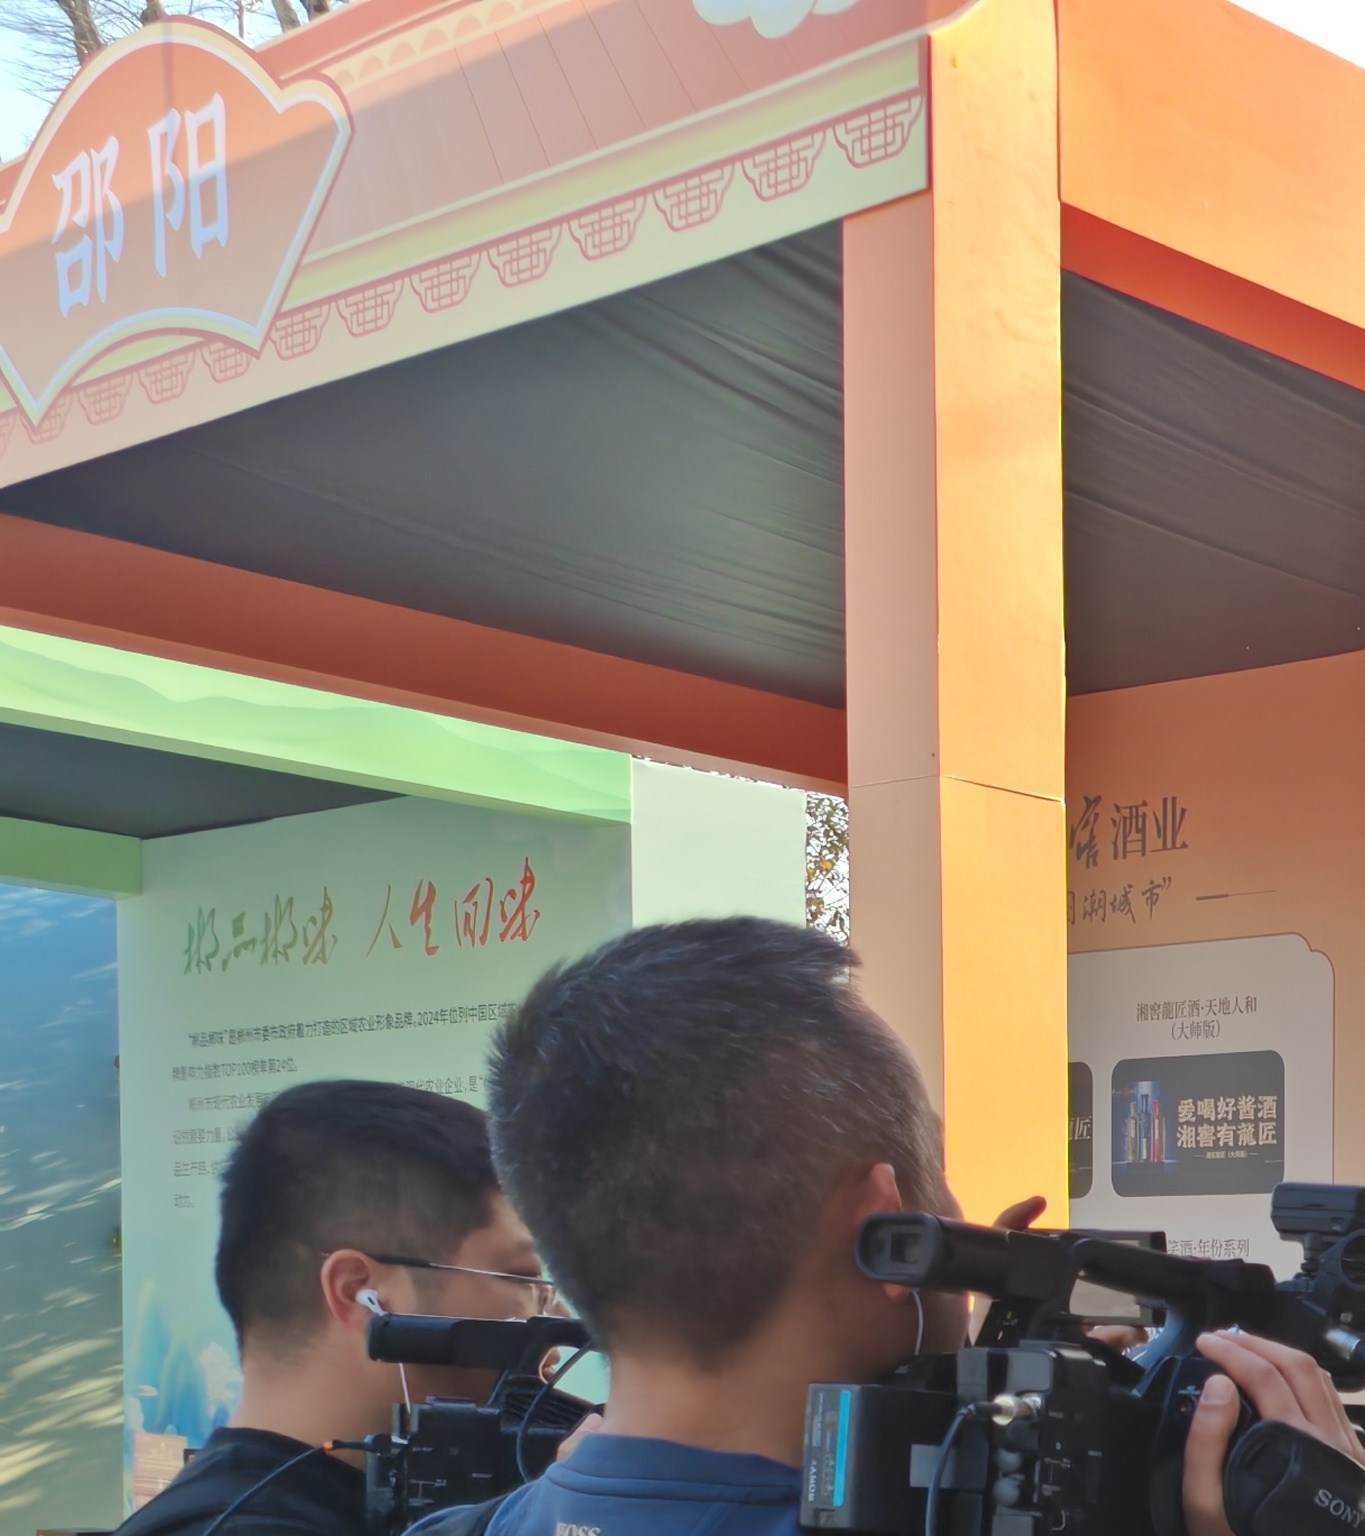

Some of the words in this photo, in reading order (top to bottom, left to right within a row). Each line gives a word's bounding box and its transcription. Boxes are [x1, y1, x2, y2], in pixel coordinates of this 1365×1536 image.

[51, 92, 229, 317] 邵阳
[1177, 1095, 1278, 1123] 爱喝好酱酒
[1313, 1488, 1365, 1529] SONY
